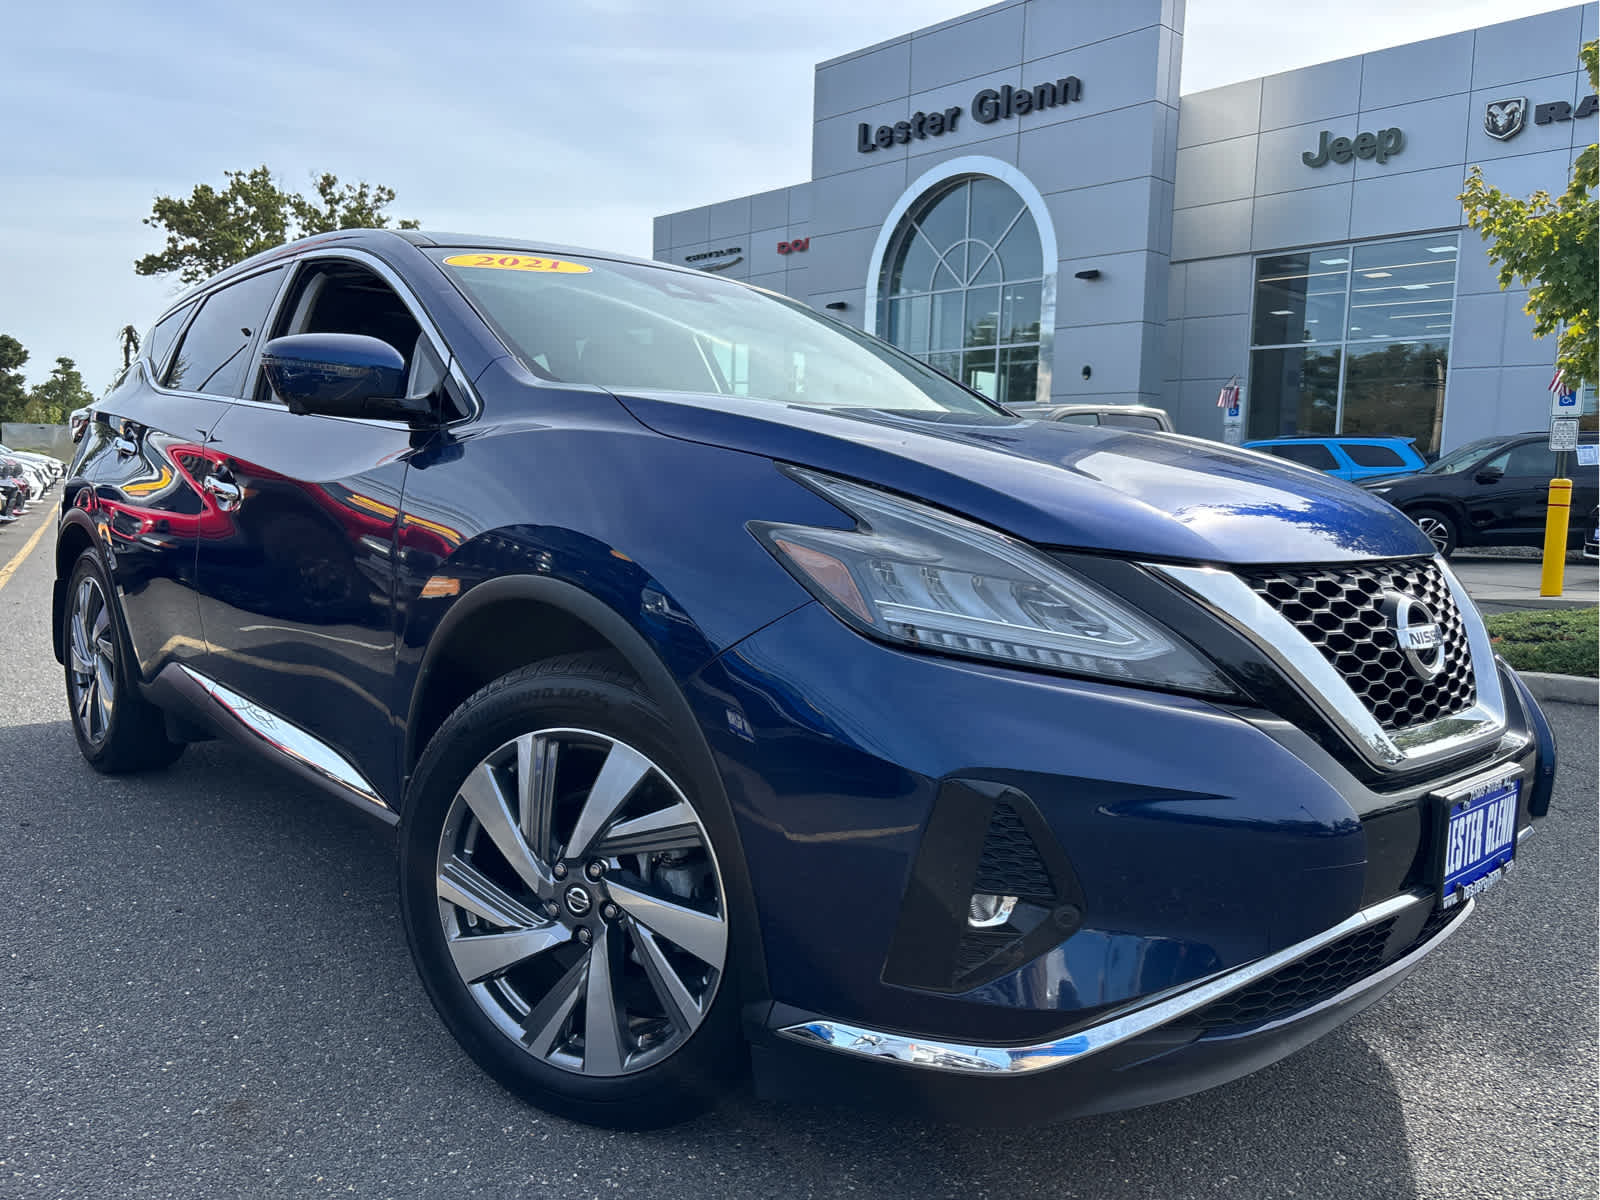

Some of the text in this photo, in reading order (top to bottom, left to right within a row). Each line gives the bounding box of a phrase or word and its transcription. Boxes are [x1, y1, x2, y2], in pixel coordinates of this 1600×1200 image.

[857, 75, 1081, 153] Lester Glenn
[1302, 127, 1405, 168] Jeep
[474, 256, 560, 270] 2021
[1408, 628, 1443, 646] NISS
[1445, 794, 1517, 877] LESTER GLENN
